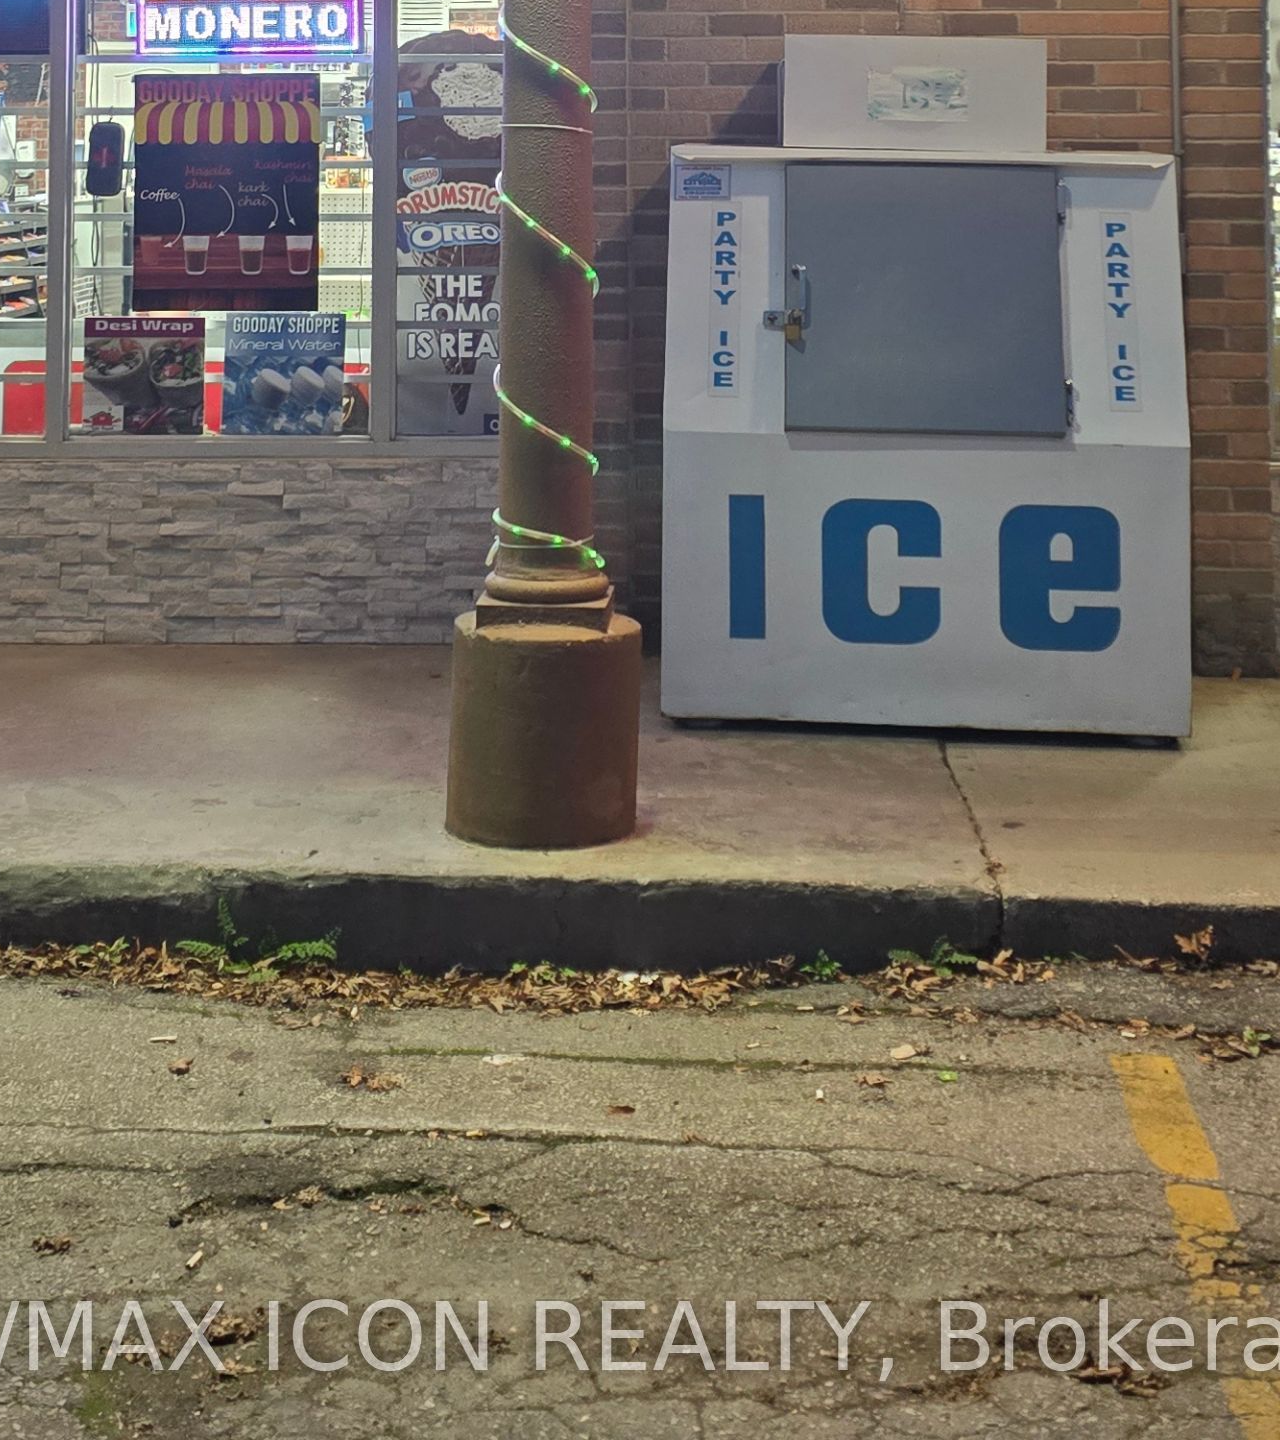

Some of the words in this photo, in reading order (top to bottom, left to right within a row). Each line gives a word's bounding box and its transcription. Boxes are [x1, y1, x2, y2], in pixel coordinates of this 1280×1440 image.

[145, 4, 348, 40] MONERO
[139, 80, 224, 103] GOODAY
[231, 78, 315, 102] SHOPPE
[140, 188, 180, 202] Coffee
[185, 177, 216, 190] chai
[238, 195, 270, 207] chai
[411, 224, 500, 247] OREO
[713, 211, 738, 305] PARTY
[1105, 222, 1132, 319] PARTY
[431, 274, 483, 298] THE
[95, 320, 137, 331] Desi
[141, 320, 194, 333] Wrap
[232, 317, 284, 334] GOODAY
[288, 317, 340, 334] SHOPPE
[229, 338, 285, 351] Mineral
[287, 339, 341, 351] Water
[407, 331, 433, 359] IS
[439, 332, 500, 359] REA
[712, 330, 735, 388] ICE
[1112, 344, 1137, 402] ICE
